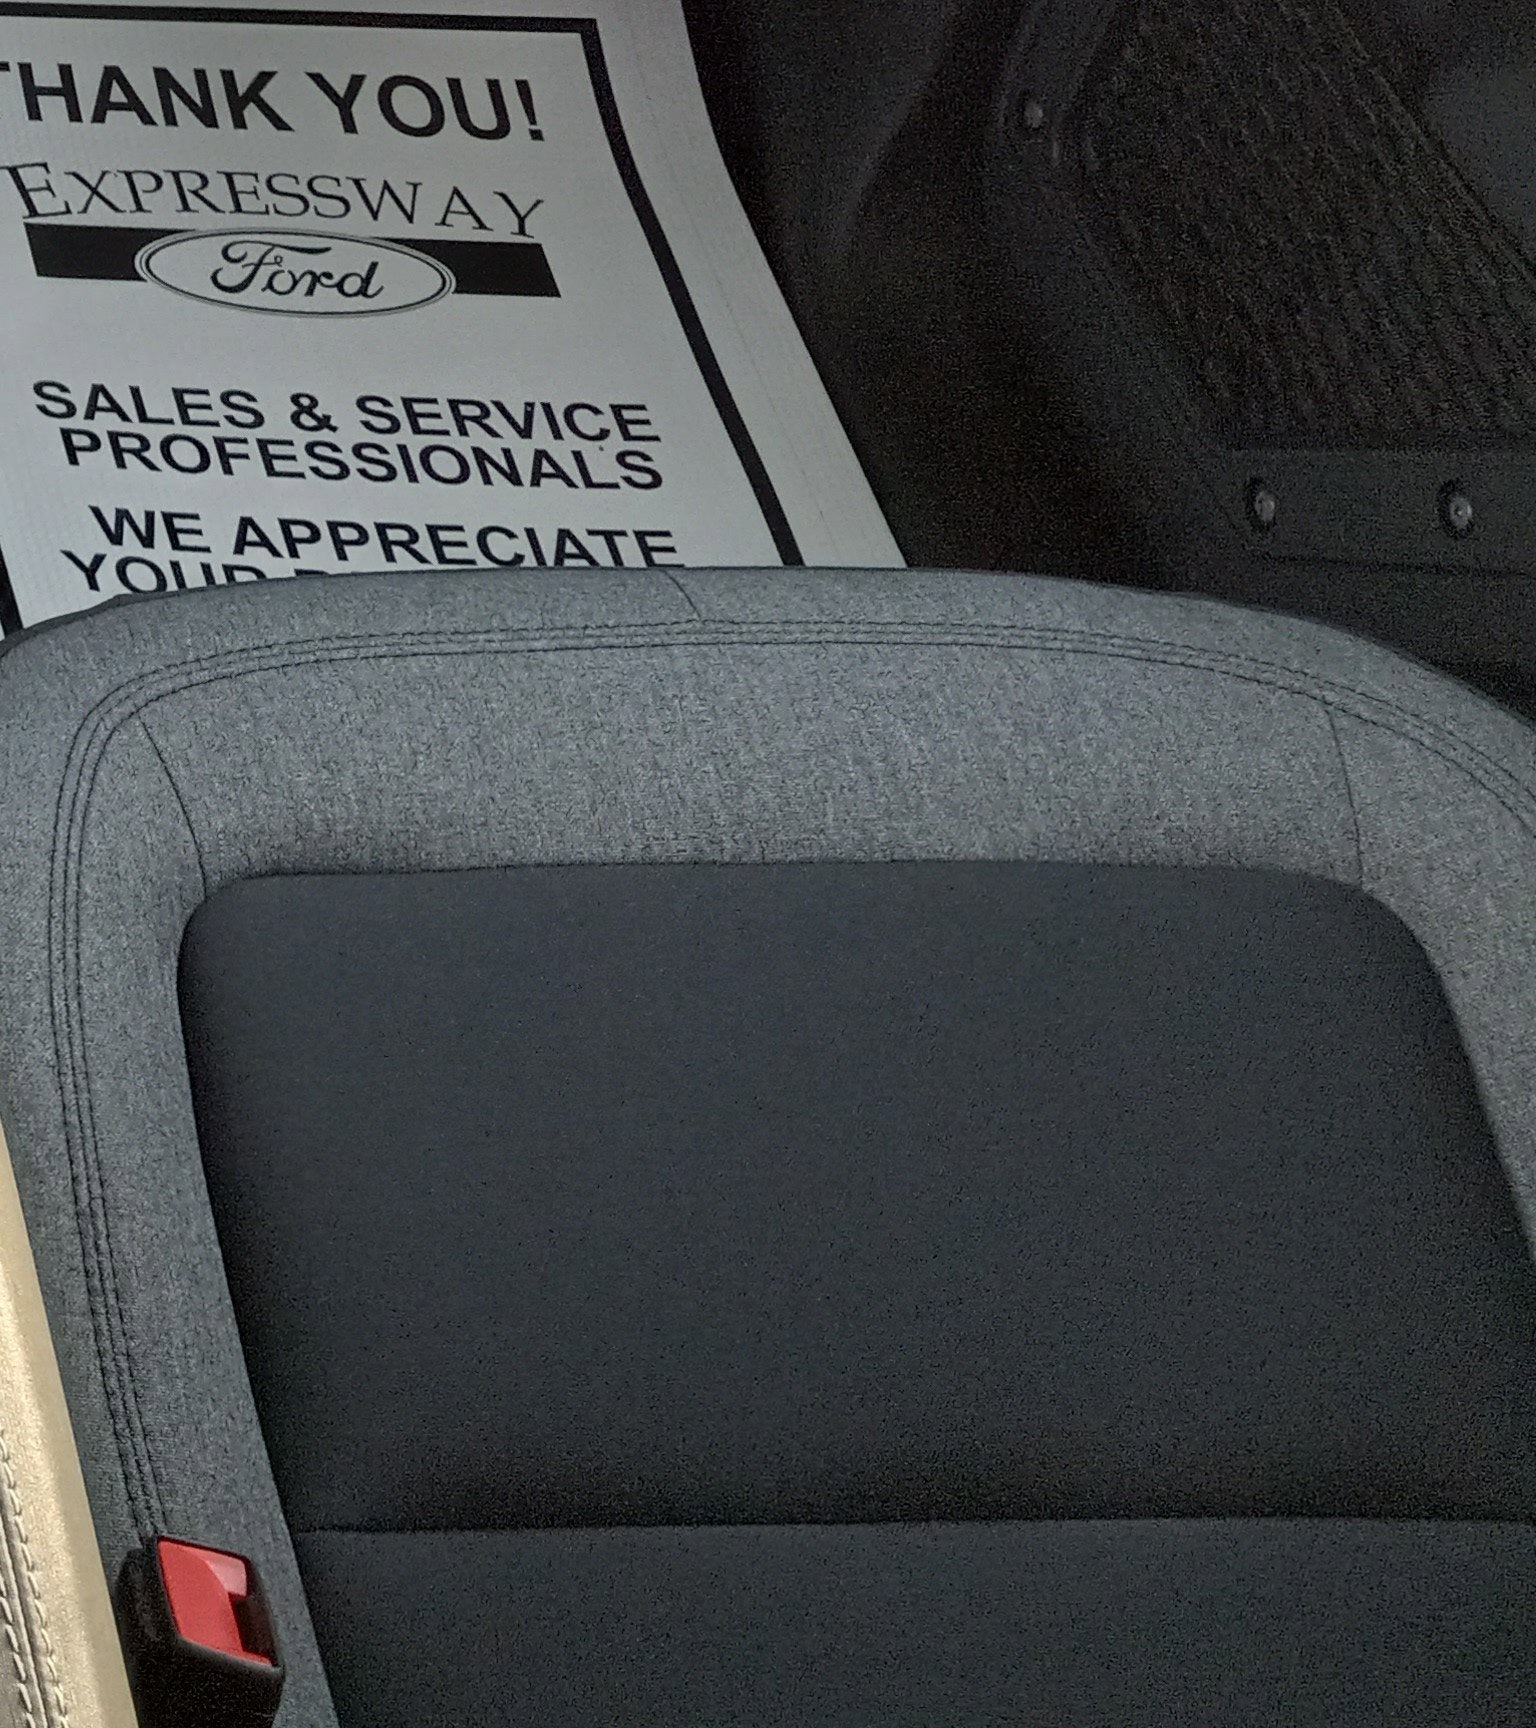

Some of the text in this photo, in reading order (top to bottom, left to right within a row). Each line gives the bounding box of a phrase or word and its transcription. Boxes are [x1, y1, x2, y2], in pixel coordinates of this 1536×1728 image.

[307, 73, 546, 142] YOU!
[210, 240, 385, 300] Ford
[33, 379, 661, 443] SALES & SERVICE
[61, 428, 663, 490] PROFESSIONALS
[90, 504, 686, 569] WE APPRECIATE
